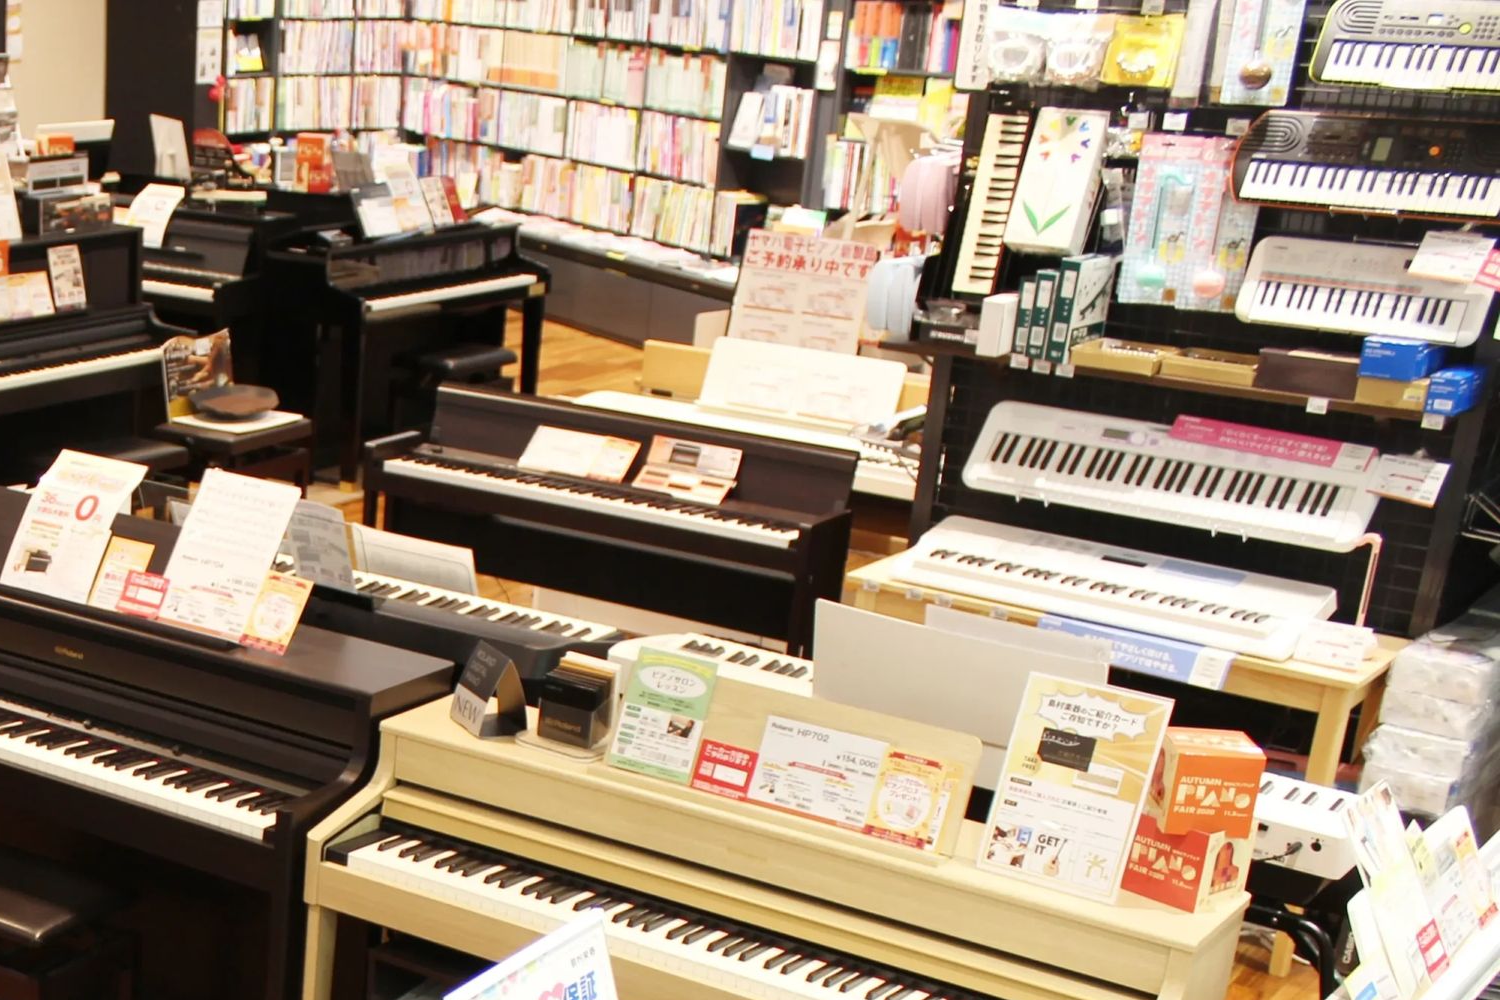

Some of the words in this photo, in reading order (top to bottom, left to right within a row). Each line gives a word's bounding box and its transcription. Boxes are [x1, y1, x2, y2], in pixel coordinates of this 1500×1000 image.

[750, 233, 878, 262] ヤマハ電子ピアノ新製品
[746, 250, 871, 279] ご予約承り中です
[651, 670, 695, 688] ピアノサロン
[656, 681, 687, 695] レッスン
[454, 694, 483, 724] NEW
[1047, 698, 1138, 727] 島村楽器のご紹介カード
[771, 721, 794, 733] Roland
[796, 728, 830, 744] HP702
[1181, 776, 1222, 786] AUTUMN
[1175, 783, 1251, 809] PIANO
[1173, 805, 1196, 814] FAIR
[1037, 833, 1061, 848] GET
[1135, 834, 1171, 852] AUTUMN
[1034, 844, 1047, 856] IT
[1128, 862, 1148, 875] FAIR
[1130, 842, 1196, 881] PIANO
